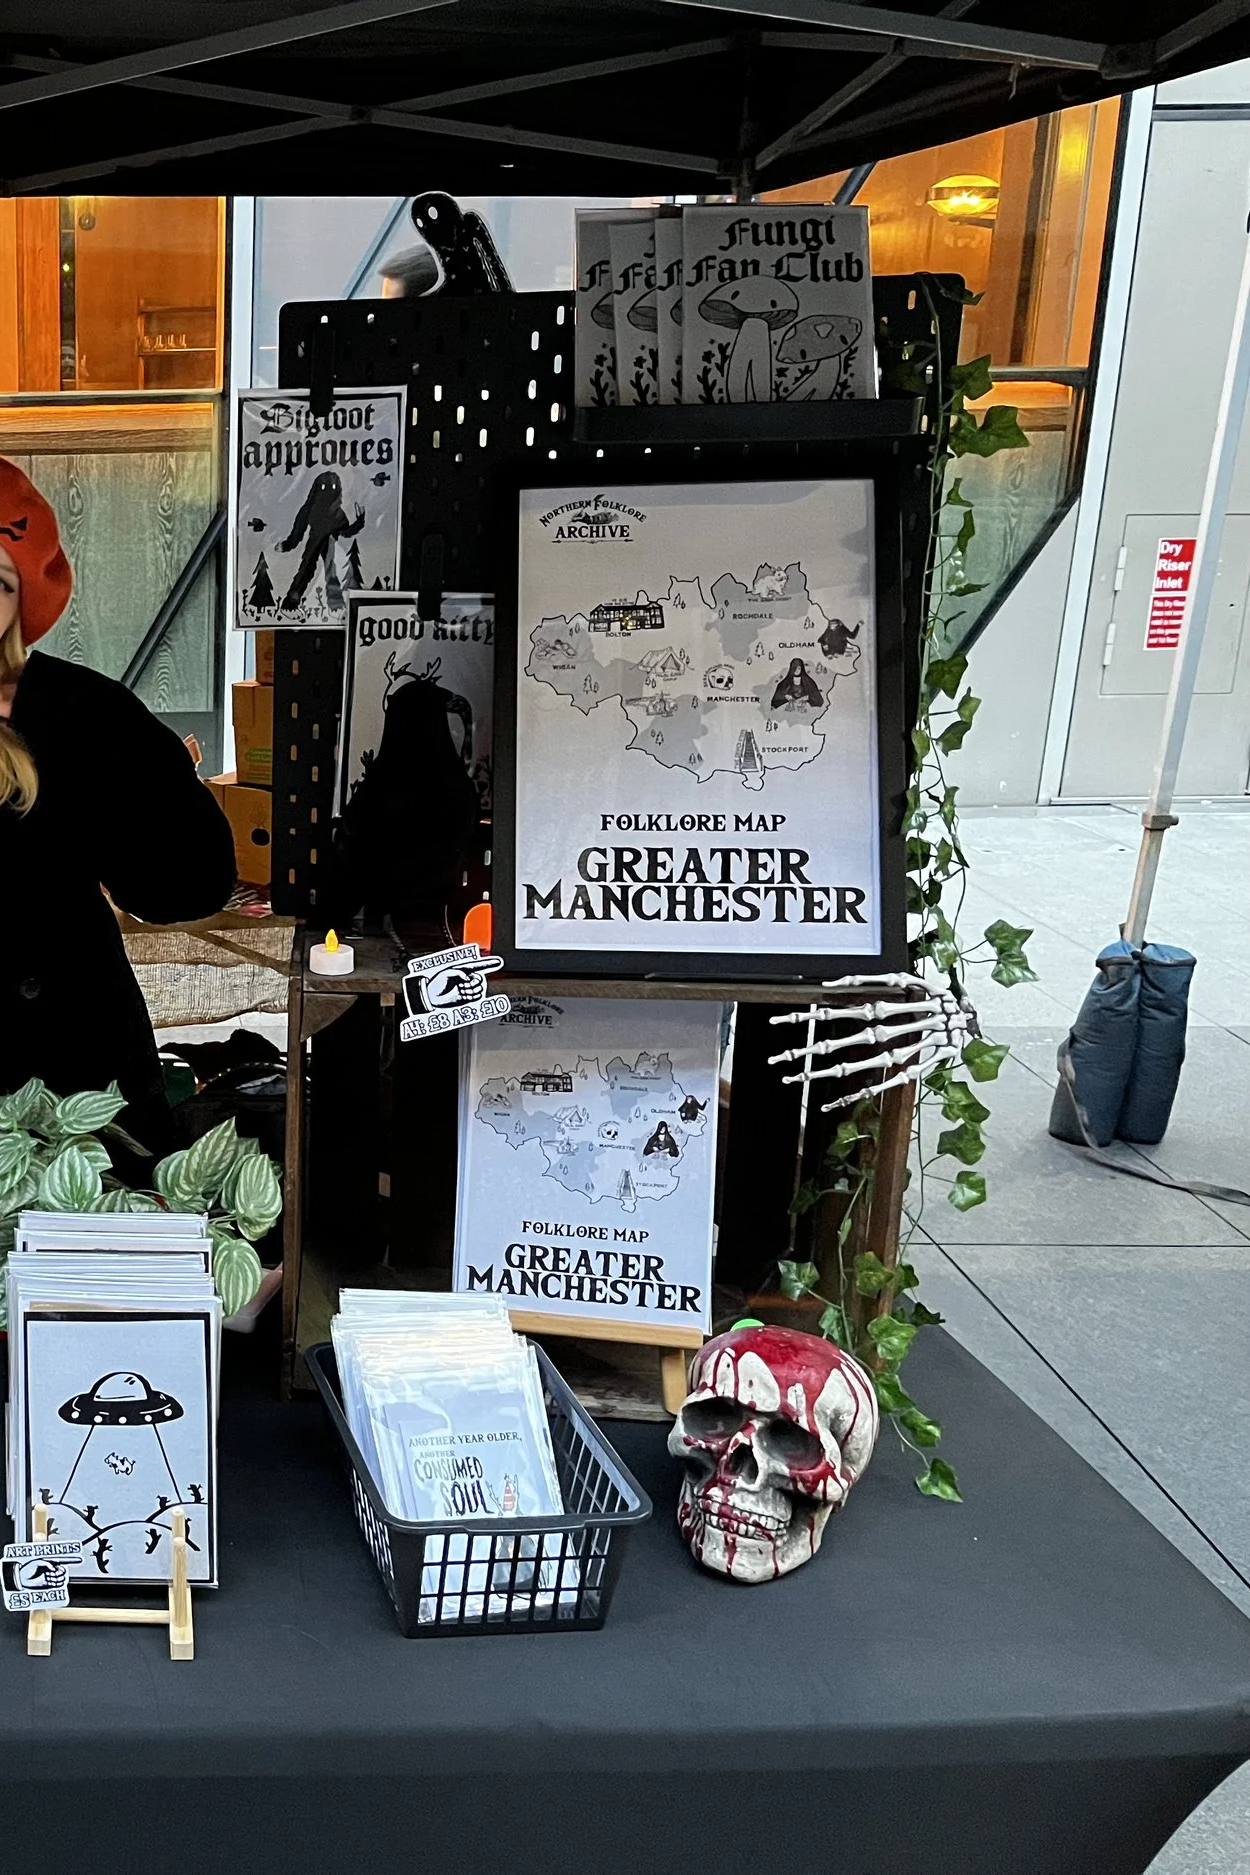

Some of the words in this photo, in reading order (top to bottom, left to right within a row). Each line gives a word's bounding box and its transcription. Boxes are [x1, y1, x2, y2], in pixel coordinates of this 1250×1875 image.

[718, 216, 836, 252] Fungi
[685, 255, 761, 287] Fan
[771, 252, 864, 283] Club
[539, 499, 592, 527] NORTHERN
[593, 495, 647, 523] FOLKLORE
[555, 524, 630, 539] ARCHIVE
[1161, 542, 1183, 557] Dry
[1158, 559, 1192, 571] Riser
[1155, 577, 1183, 588] Inlet
[600, 814, 726, 831] FOLKLORE
[733, 812, 787, 832] MAP
[577, 847, 812, 885] GREATER
[522, 879, 869, 923] MANCHESTER
[412, 946, 478, 972] EXCLUSIVE!
[428, 1013, 451, 1032] £8
[480, 997, 510, 1019] £10
[500, 1014, 552, 1026] ARCHIVE
[521, 1221, 609, 1241] FOLKLORE
[613, 1228, 650, 1243] MAP
[504, 1243, 666, 1282] GREATER
[466, 1265, 702, 1313] MANCHESTER
[408, 1433, 456, 1447] ANOTHER
[457, 1433, 485, 1444] YEAR
[487, 1431, 523, 1443] OLDER,
[414, 1456, 484, 1483] CONSUMED
[440, 1481, 495, 1517] SOUL
[6, 1546, 32, 1557] ART
[33, 1543, 81, 1556] PRINTS
[31, 1590, 66, 1603] EACH
